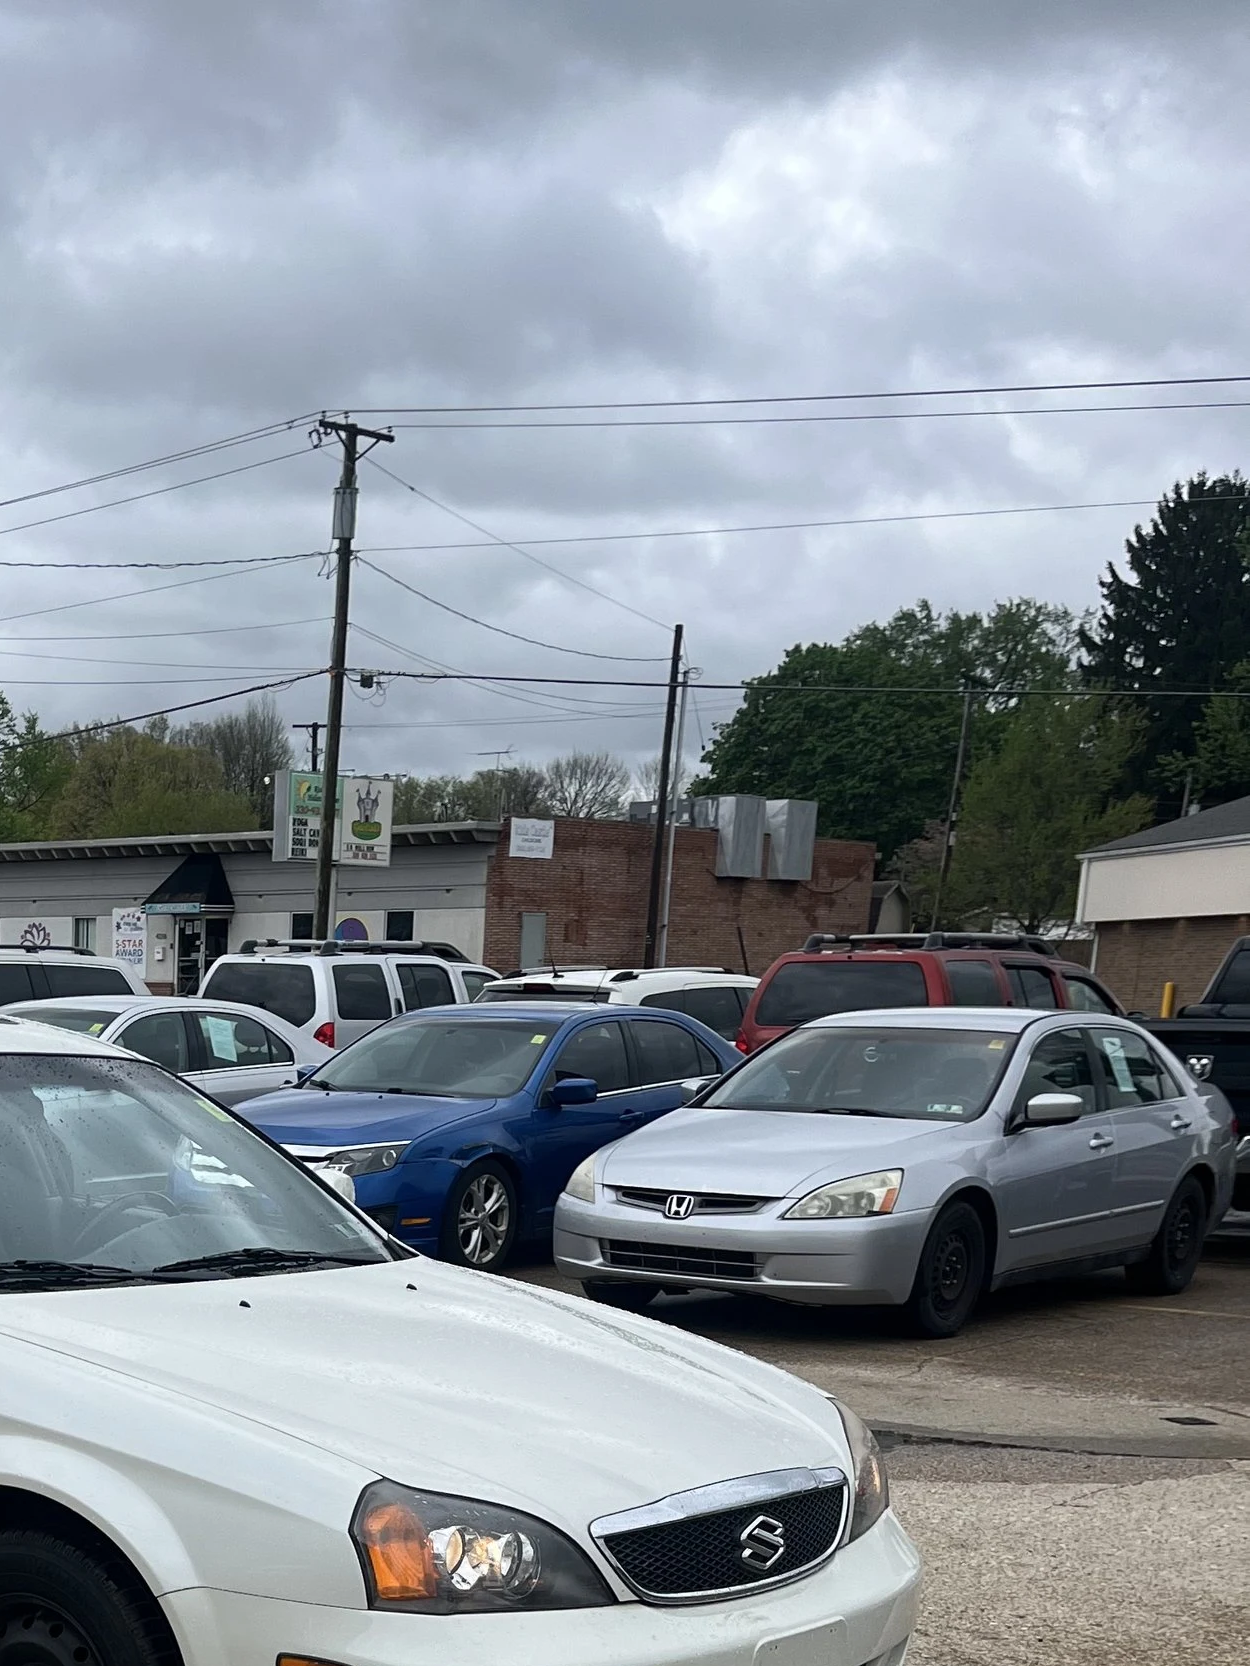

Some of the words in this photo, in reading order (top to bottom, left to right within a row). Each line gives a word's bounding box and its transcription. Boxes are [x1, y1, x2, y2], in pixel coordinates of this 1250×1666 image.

[292, 828, 307, 837] SALT
[115, 939, 144, 949] 5-STAR
[115, 948, 144, 957] AWARD
